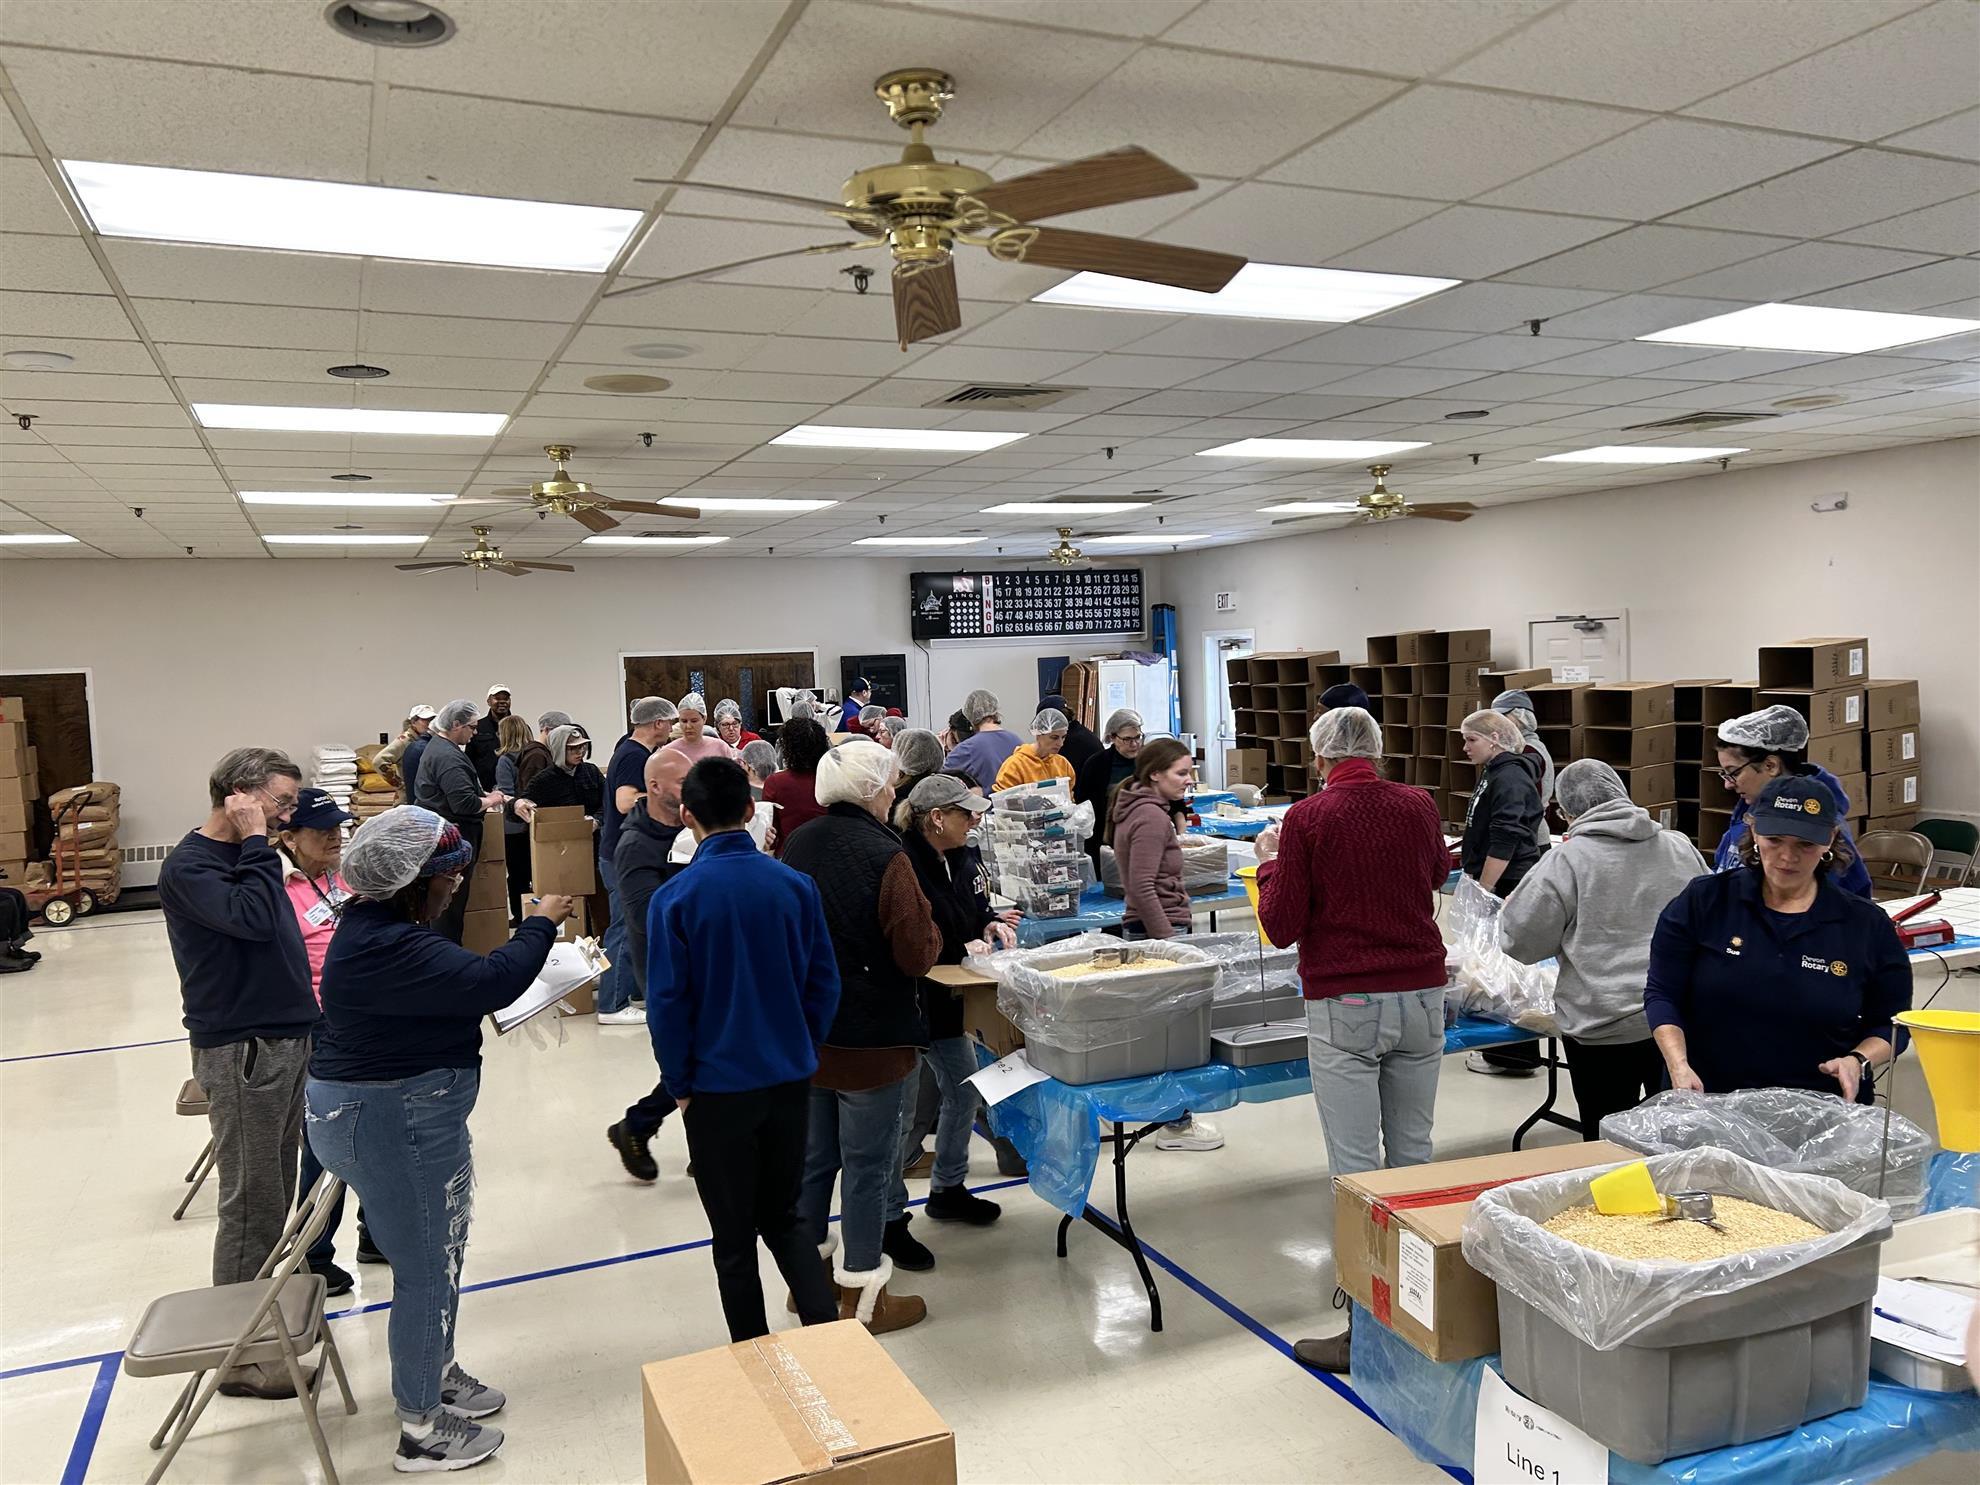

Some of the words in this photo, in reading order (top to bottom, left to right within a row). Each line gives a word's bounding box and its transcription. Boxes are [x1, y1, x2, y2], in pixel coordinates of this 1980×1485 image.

[996, 577, 999, 585] 1
[1005, 576, 1010, 585] 2
[1015, 576, 1020, 585] 3
[1025, 576, 1030, 584] 4
[1035, 576, 1040, 584] 5
[1045, 575, 1049, 584] 6
[1055, 575, 1059, 584] 7
[1066, 575, 1070, 584] 8
[1076, 575, 1080, 584] 9
[1084, 575, 1091, 583] 10
[1094, 575, 1100, 583] 11
[1103, 574, 1110, 583] 12
[1112, 574, 1119, 583] 13
[1122, 574, 1129, 583] 14
[1131, 574, 1138, 583] 15
[995, 588, 1002, 597] 16
[1005, 588, 1012, 596] 17
[1015, 587, 1022, 597] 18
[1024, 587, 1032, 596] 19
[1034, 587, 1042, 596] 20
[1044, 587, 1051, 596] 21
[1053, 587, 1061, 596] 22
[1065, 586, 1073, 595] 23
[1075, 586, 1082, 595] 24
[1084, 586, 1092, 595] 25
[1093, 586, 1101, 595] 26
[1103, 585, 1111, 594] 27
[1112, 585, 1120, 594] 28
[1121, 585, 1129, 594] 29
[1131, 585, 1139, 594] 30
[995, 600, 1002, 609] 31
[1004, 599, 1013, 608] 32
[1014, 599, 1023, 608] 33
[1024, 599, 1032, 608] 34
[1034, 599, 1043, 608] 35
[1044, 599, 1052, 608] 36
[1054, 599, 1062, 607] 37
[1065, 598, 1073, 607] 38
[1075, 598, 1083, 607] 39
[1084, 597, 1092, 606] 40
[1094, 598, 1102, 606] 41
[1103, 597, 1111, 606] 42
[1113, 597, 1121, 605] 43
[1122, 597, 1130, 605] 44
[1131, 596, 1139, 605] 45
[1218, 593, 1228, 608] EXIT
[995, 611, 1003, 620] 46
[1005, 611, 1013, 620] 47
[1015, 611, 1023, 620] 48
[1025, 611, 1033, 620] 49
[1035, 610, 1043, 619] 50
[1045, 610, 1052, 619] 51
[1054, 610, 1062, 619] 52
[1065, 609, 1074, 618] 53
[1075, 609, 1083, 618] 54
[1085, 609, 1093, 618] 55
[1094, 609, 1102, 618] 56
[1104, 609, 1111, 617] 57
[1113, 608, 1121, 617] 58
[1122, 608, 1130, 617] 59
[1132, 608, 1139, 617] 60
[995, 623, 1003, 632] 61
[1005, 623, 1013, 632] 62
[1015, 623, 1023, 632] 63
[1025, 623, 1033, 632] 64
[1035, 622, 1043, 631] 65
[1045, 622, 1053, 631] 66
[1054, 622, 1062, 631] 67
[1065, 621, 1074, 630] 68
[1075, 621, 1083, 630] 69
[1085, 620, 1093, 629] 70
[1095, 620, 1102, 629] 71
[1104, 620, 1112, 629] 72
[1113, 620, 1121, 628] 73
[1123, 619, 1130, 628] 74
[1132, 619, 1140, 628] 75
[1774, 801, 1803, 811] Rotary
[1801, 955, 1825, 964] Devon
[1801, 960, 1829, 973] Rotary
[1507, 1442, 1545, 1480] Line
[1552, 1471, 1559, 1485] 1
